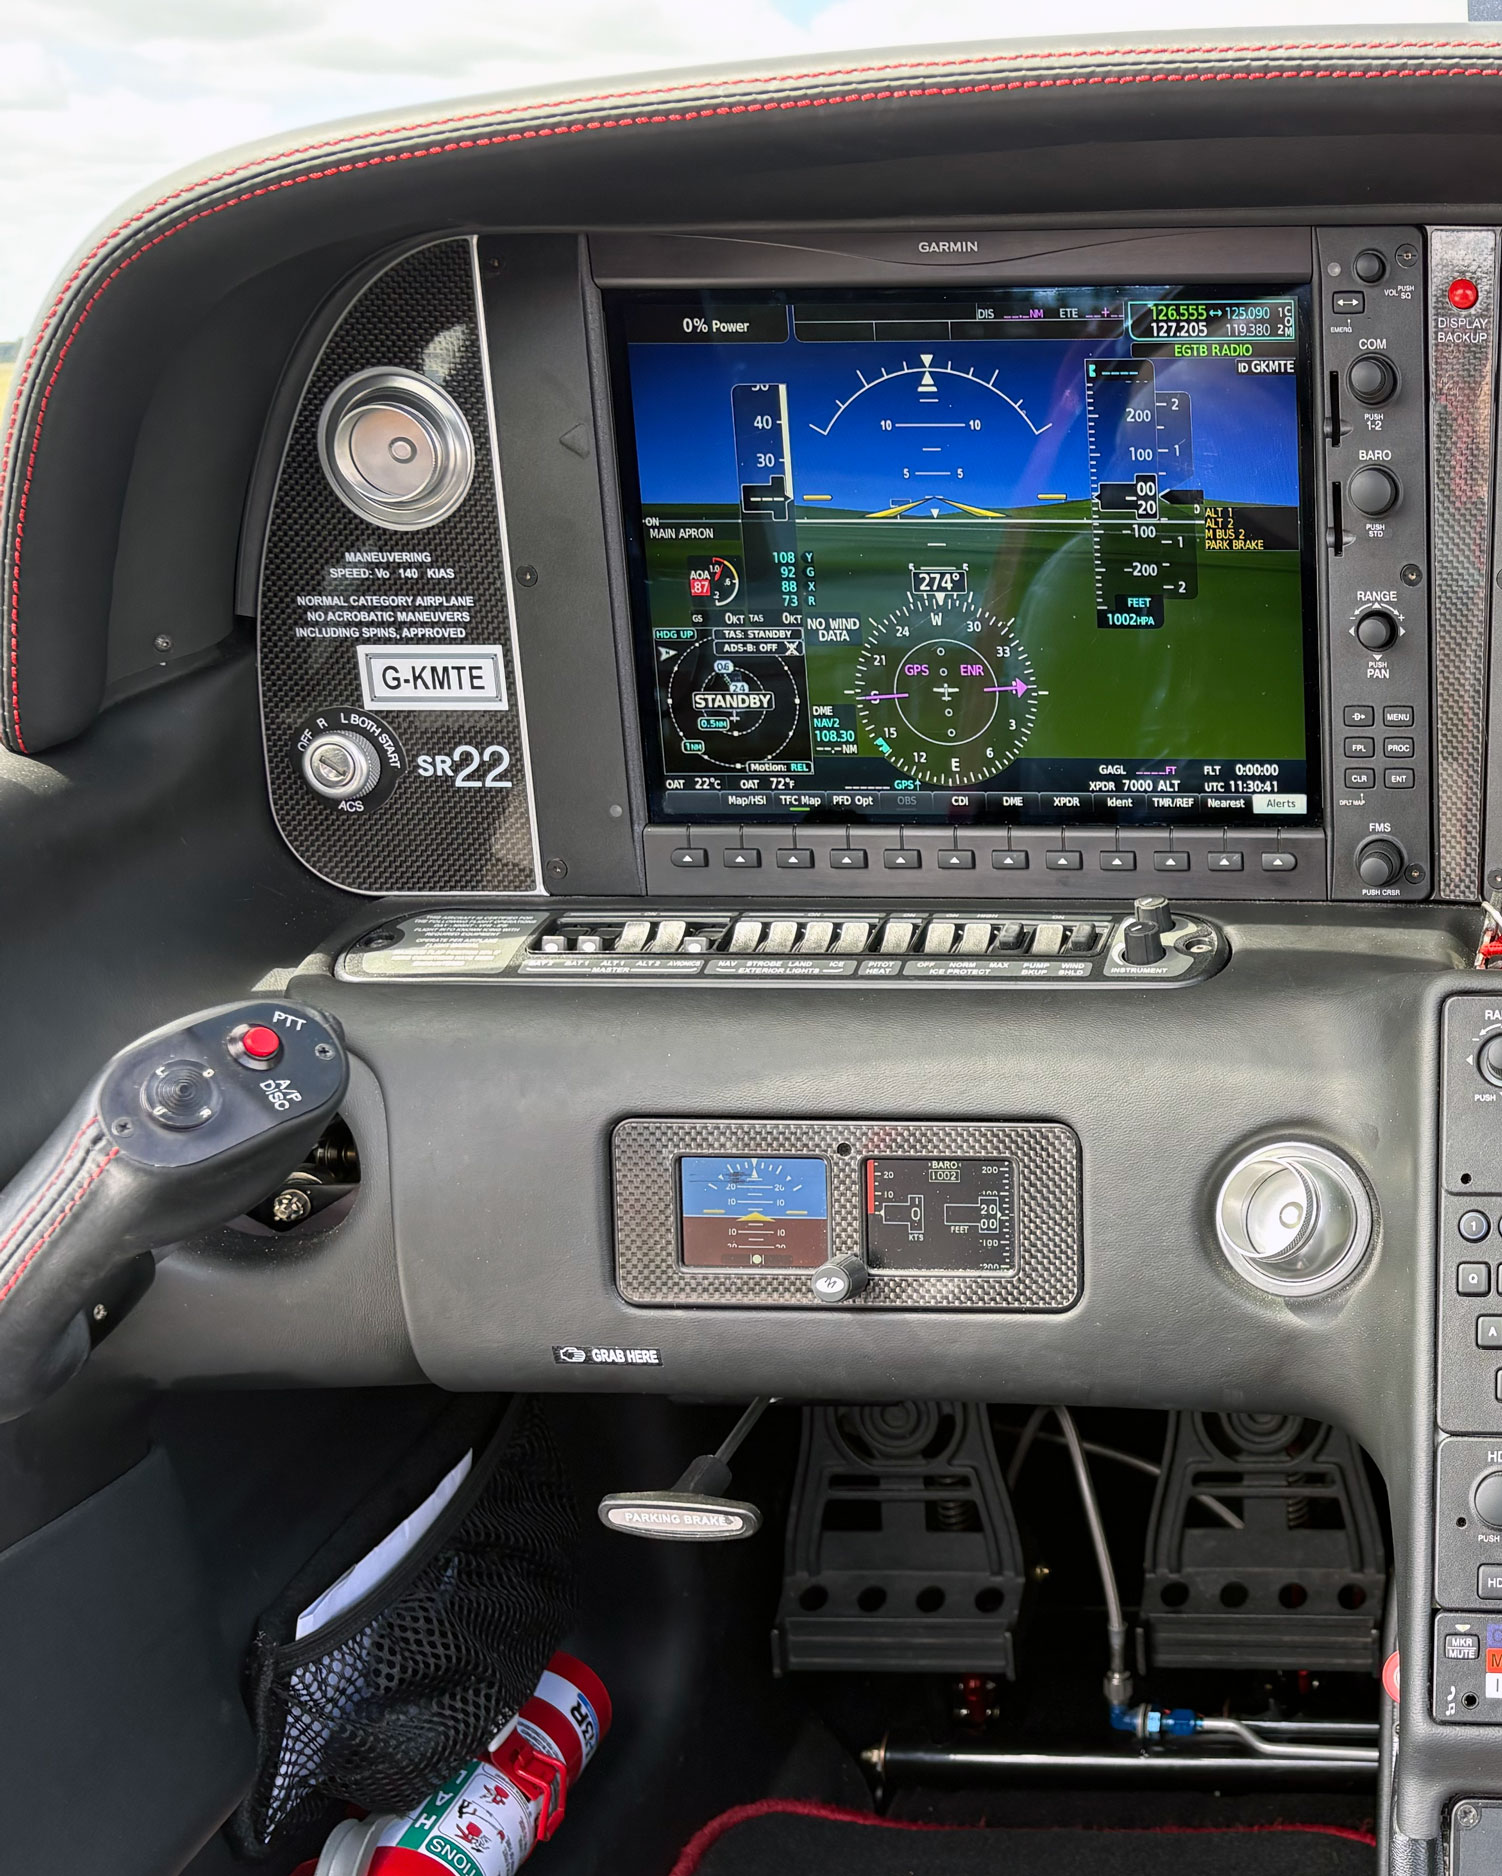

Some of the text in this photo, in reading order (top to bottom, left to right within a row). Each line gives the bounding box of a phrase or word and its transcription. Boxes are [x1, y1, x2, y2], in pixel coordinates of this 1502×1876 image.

[918, 241, 977, 252] GARMIN
[1151, 306, 1270, 320] 126.555 125.090
[683, 318, 749, 333] 0% Power
[1438, 319, 1487, 329] DISPLAY
[1151, 323, 1270, 337] 127.205 119.380
[1438, 333, 1487, 343] BACKUP
[1359, 339, 1386, 349] COM
[1175, 344, 1252, 357] EGTB RADIO
[1238, 361, 1294, 373] ID GKMTE
[1359, 451, 1391, 460] BARO
[1206, 508, 1232, 517] ALT 1
[1206, 518, 1233, 527] ALT 2
[650, 529, 713, 538] MAIN APRON
[1206, 529, 1245, 539] M BUS 2
[1206, 540, 1264, 549] PARK BRAKE
[345, 553, 431, 562] MANEUVERING
[330, 569, 454, 578] SPEED: Vo 140 KIAS
[297, 596, 474, 606] NORMAL CATEGORY AIRPLANE
[1357, 591, 1397, 601] RANGE
[1128, 598, 1151, 607] FEET
[307, 612, 470, 621] NO ACROBATIC MANEUVERS
[807, 619, 859, 629] NO WIND
[296, 628, 465, 639] INCLUDING SPINS, APPROVED
[819, 631, 849, 641] DATA
[905, 665, 929, 675] GPS
[960, 665, 984, 675] ENR
[1367, 669, 1389, 678] PAN
[382, 666, 485, 690] G-KMTE
[695, 695, 770, 708] STANDBY
[813, 707, 833, 715] DME
[814, 719, 839, 727] NAV2
[815, 731, 854, 741] 108.30
[417, 745, 512, 787] SR22
[1204, 765, 1279, 775] FLT 0:00:00
[1090, 781, 1180, 791] XPDR 7000 ALT
[1205, 781, 1278, 792] UTC 11:30:41
[339, 800, 364, 812] ACS
[1208, 799, 1244, 808] Nearest
[1267, 799, 1295, 807] Alerts
[1369, 824, 1390, 832] FMS
[273, 1011, 307, 1030] PTT
[260, 1080, 289, 1110] DISC
[275, 1080, 302, 1101] A/P
[592, 1349, 659, 1363] GRAB HERE
[625, 1513, 727, 1526] PARKING BRAKE
